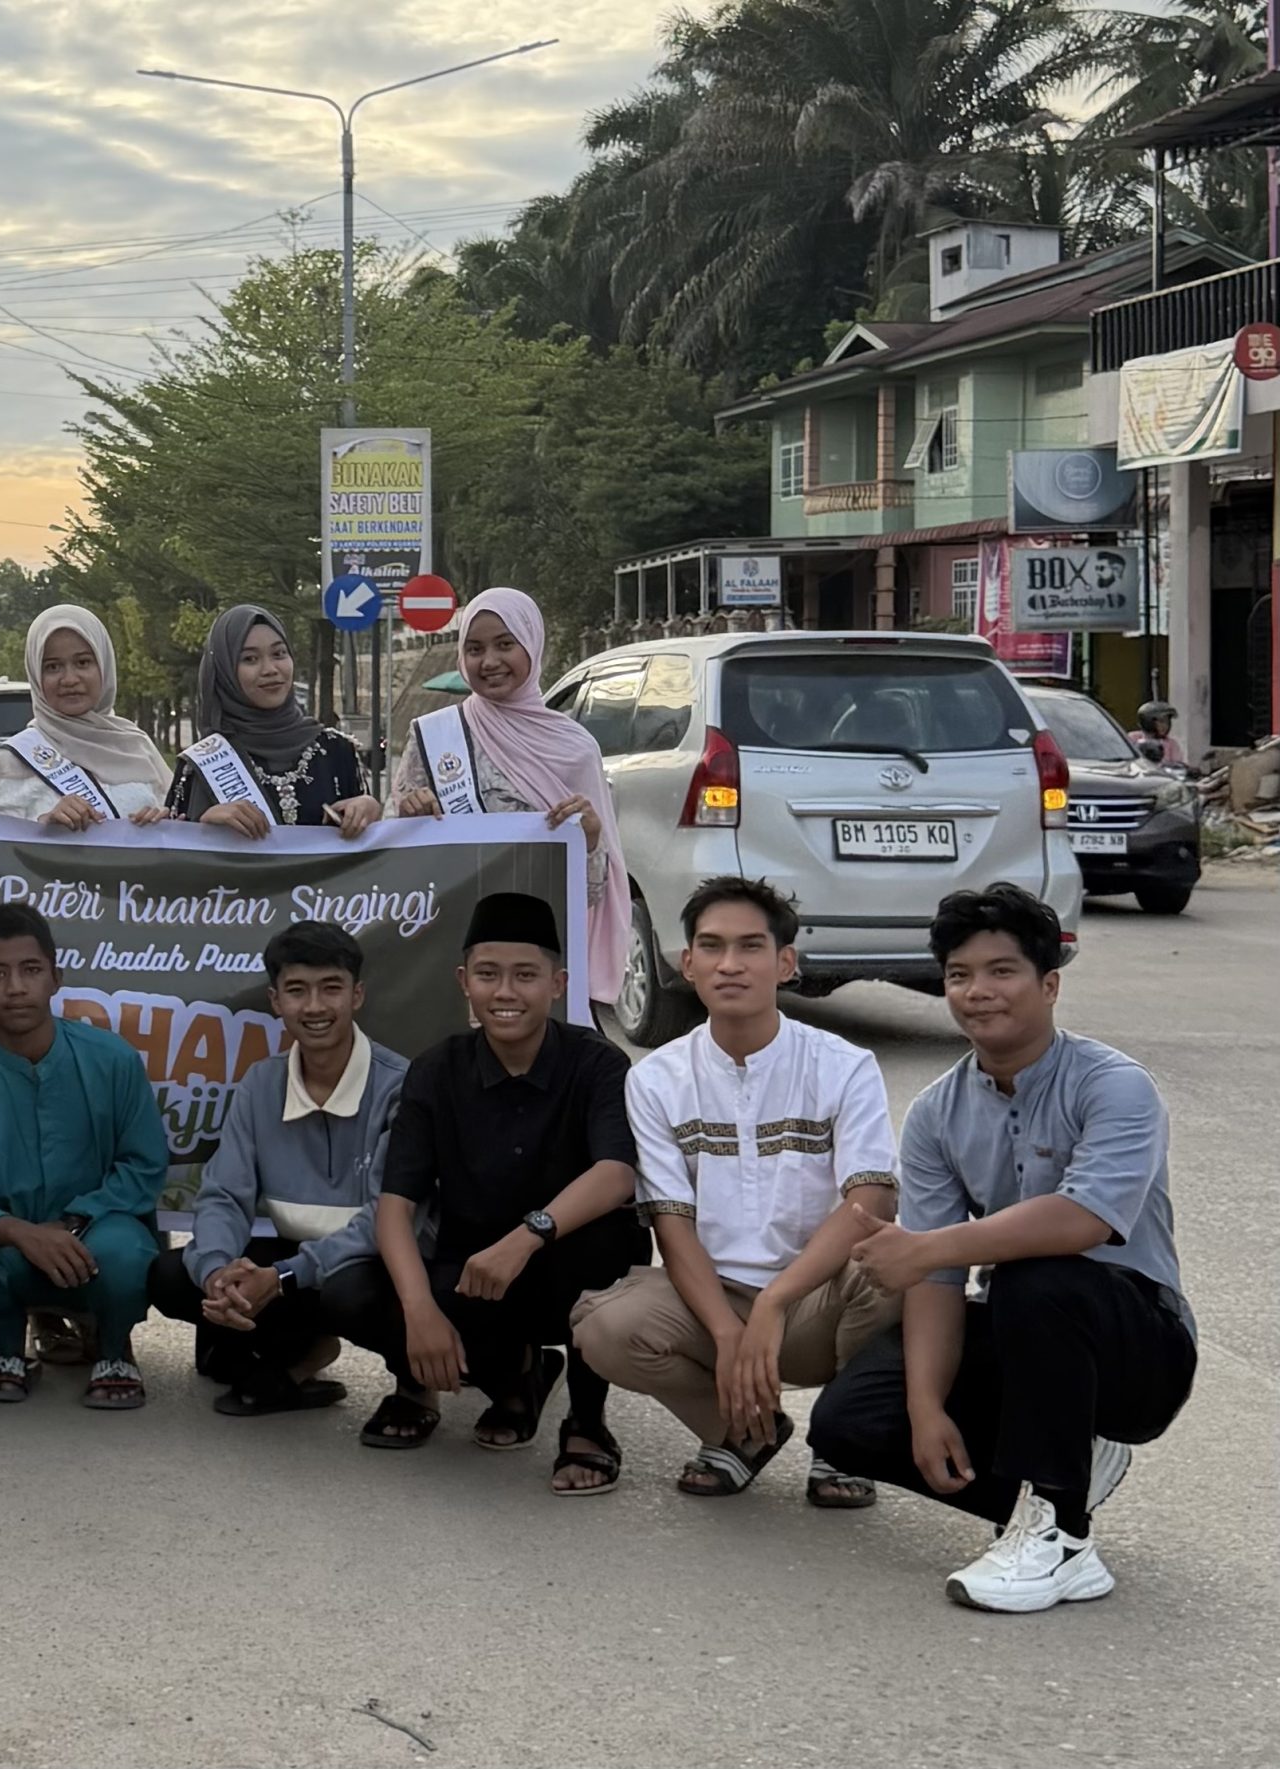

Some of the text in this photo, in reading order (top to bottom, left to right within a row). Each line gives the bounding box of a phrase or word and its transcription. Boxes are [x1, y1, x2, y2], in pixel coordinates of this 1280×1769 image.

[329, 491, 423, 514] SAFETY BELT
[841, 823, 949, 844] BM 1105 KQ
[118, 880, 276, 925] Kuantan
[289, 882, 440, 938] Singingi
[90, 941, 191, 972] Ibadah
